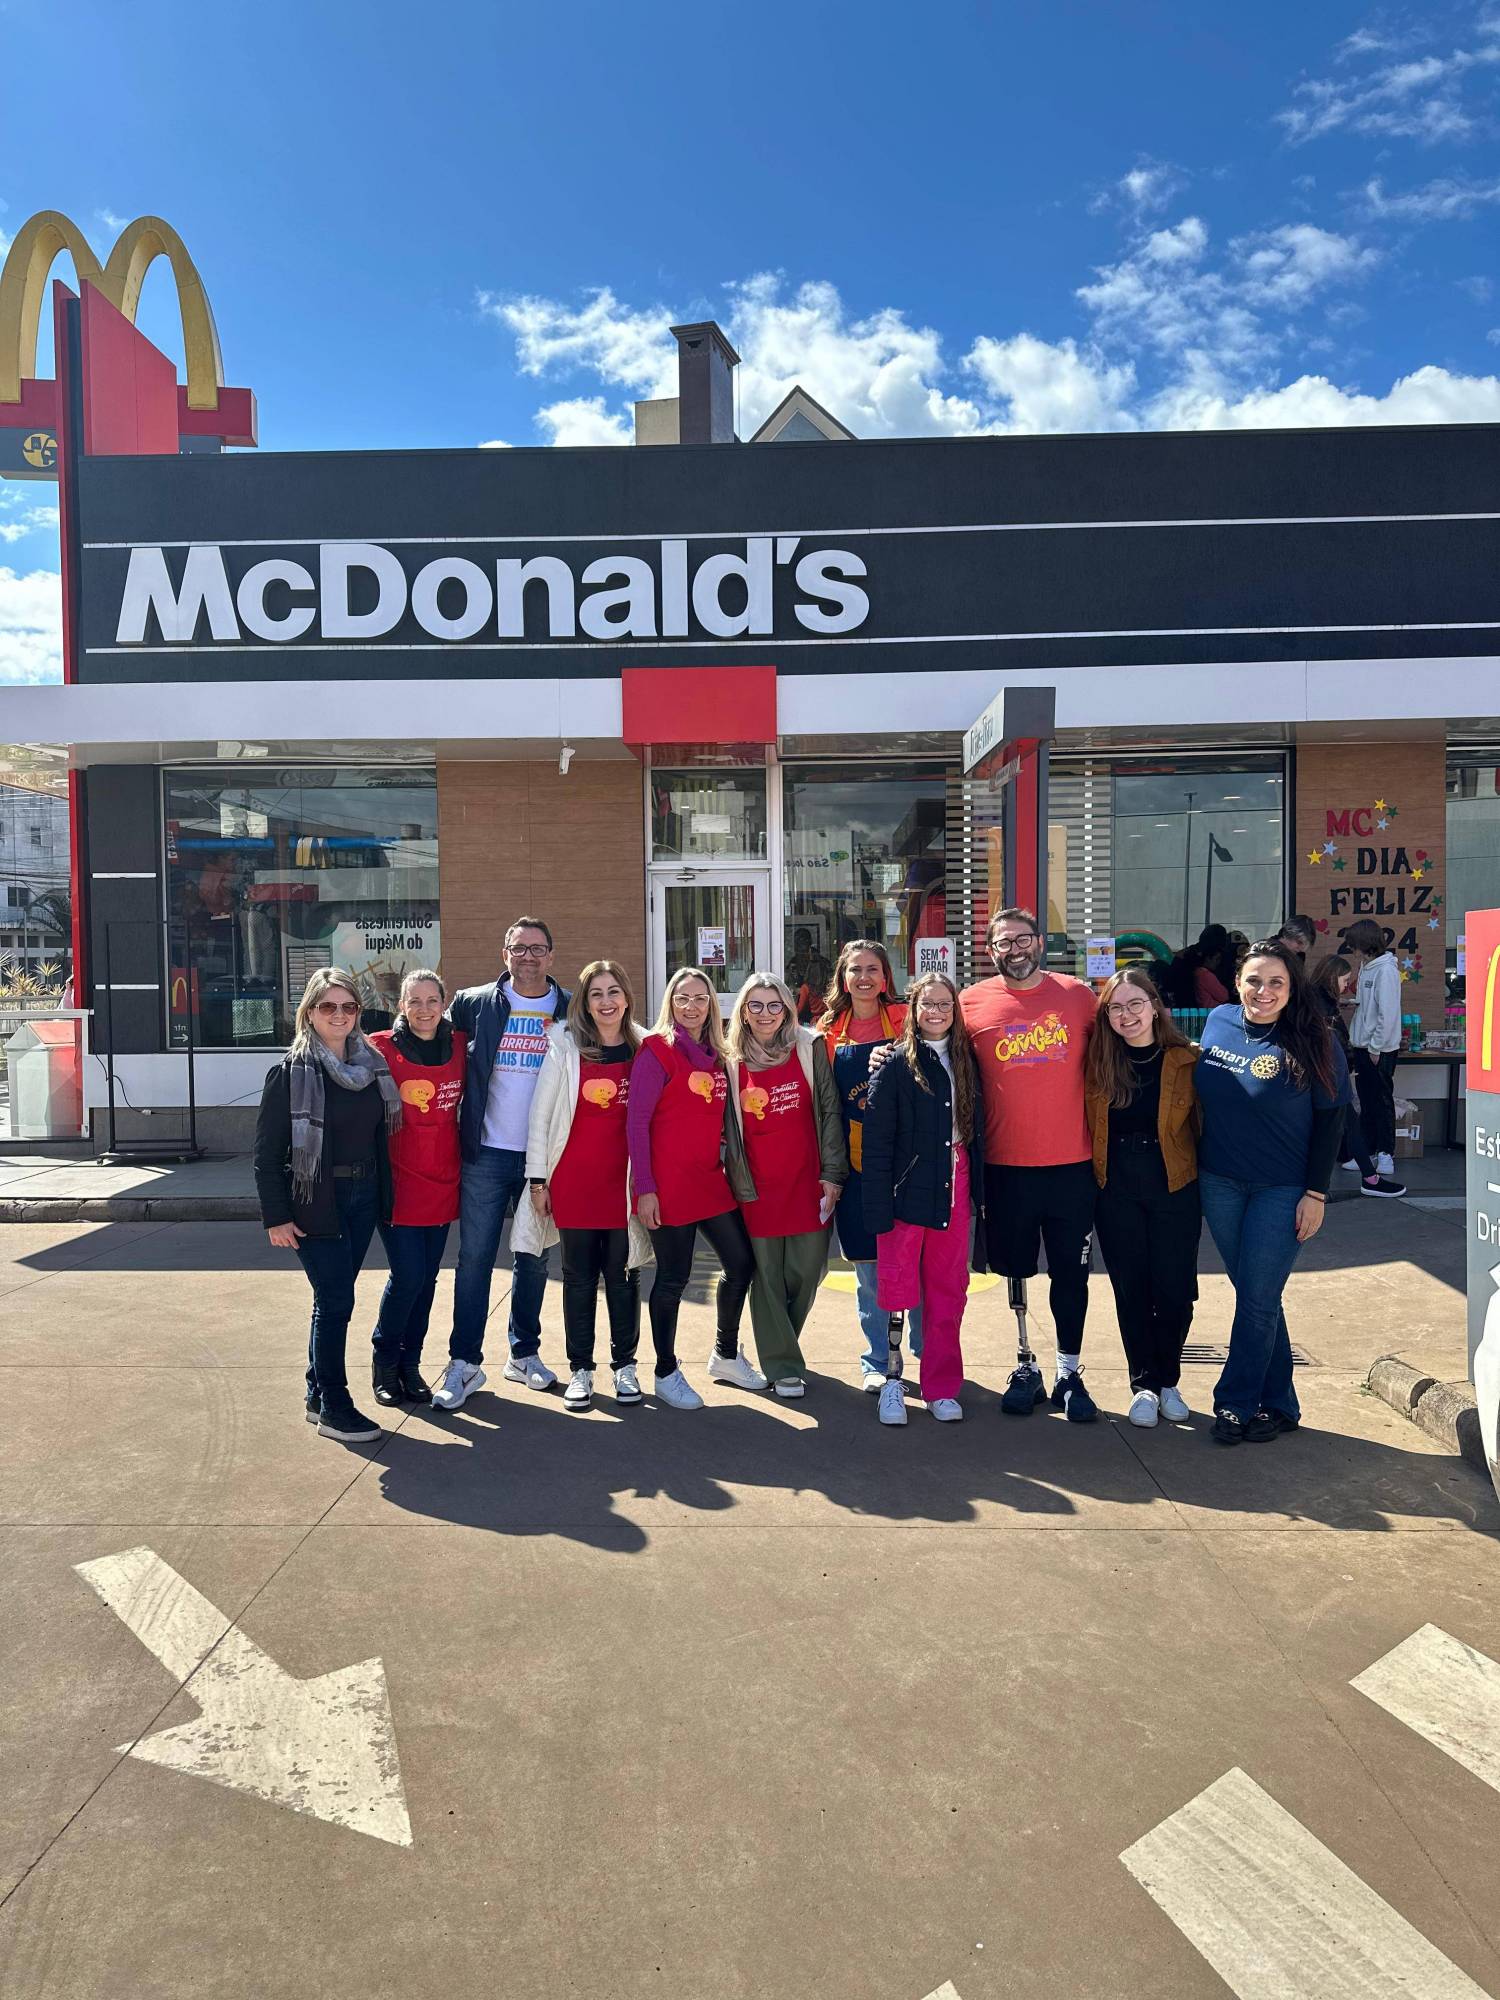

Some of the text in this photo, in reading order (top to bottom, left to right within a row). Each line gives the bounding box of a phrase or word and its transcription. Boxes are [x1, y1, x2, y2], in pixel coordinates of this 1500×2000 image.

[115, 537, 870, 645] McDonald's
[1326, 808, 1373, 837] MC
[1357, 847, 1413, 875] DIA
[1330, 886, 1433, 915] FELIZ
[920, 948, 939, 961] SEM
[1337, 927, 1419, 955] 224
[920, 961, 948, 973] PARAR
[504, 1017, 544, 1036] NTOS
[995, 1025, 1068, 1062] CORAGEM
[1209, 1045, 1250, 1067] Rotary
[847, 1081, 870, 1101] VOLU
